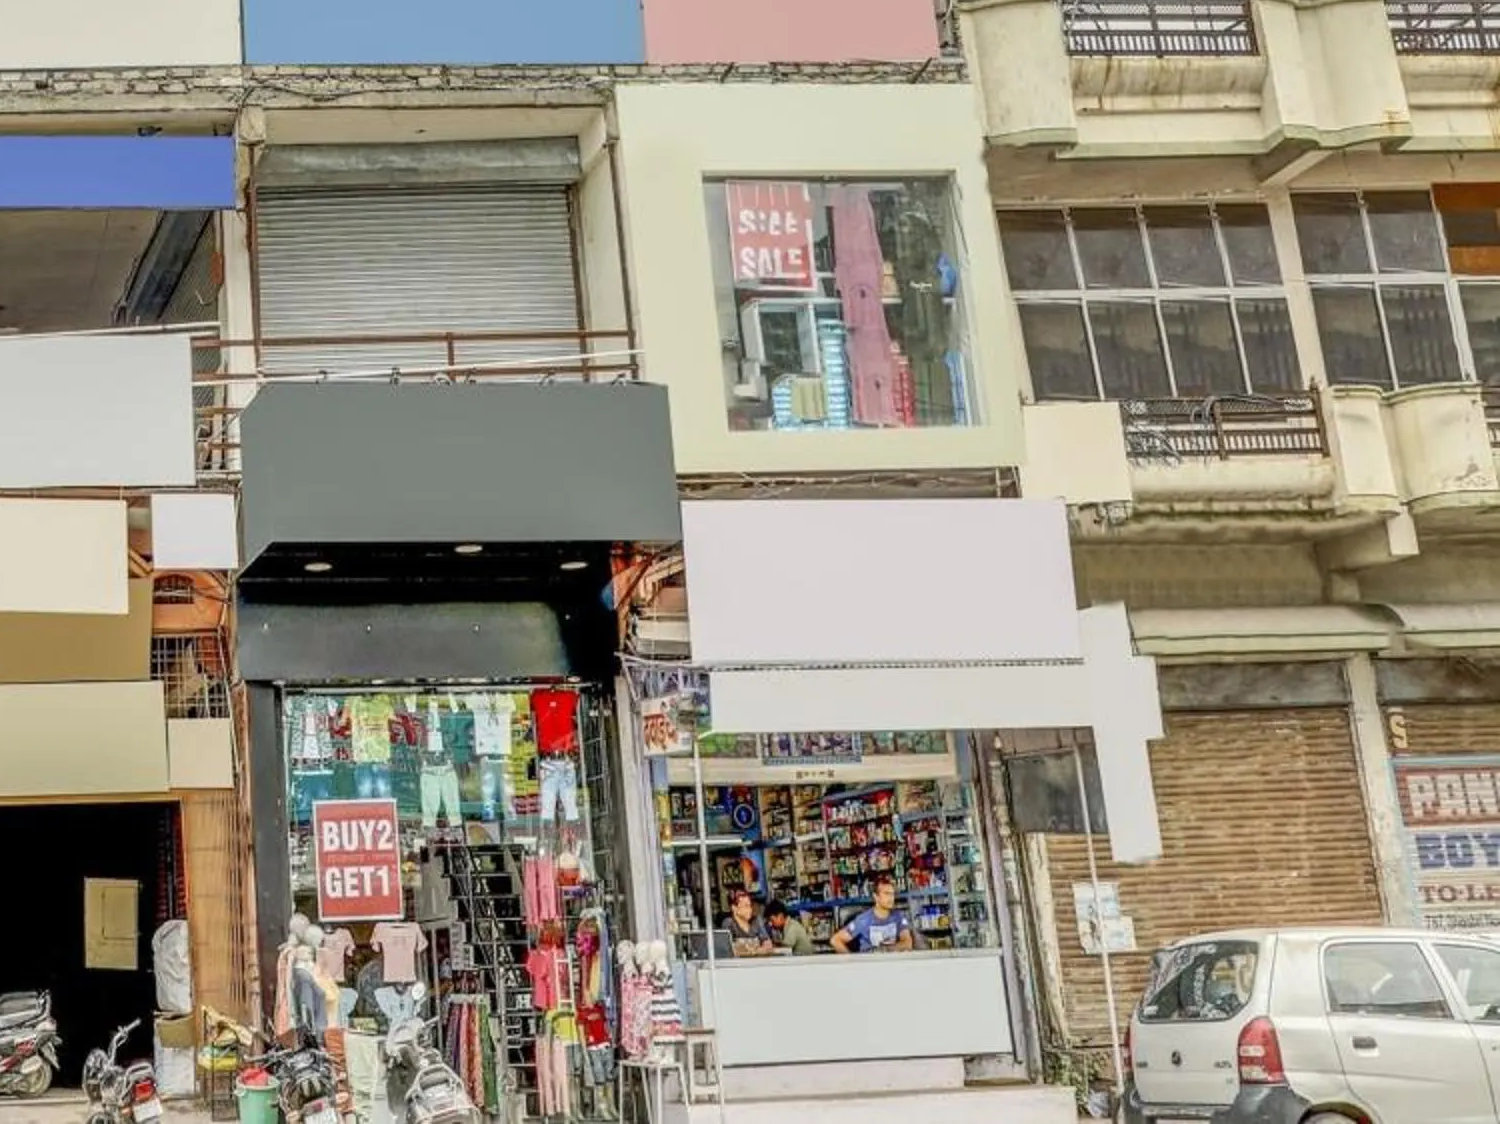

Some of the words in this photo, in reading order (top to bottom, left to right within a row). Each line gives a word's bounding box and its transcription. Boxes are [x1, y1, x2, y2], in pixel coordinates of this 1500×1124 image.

[1405, 772, 1500, 819] PAN
[322, 819, 394, 852] BUY2
[325, 865, 391, 899] GET1
